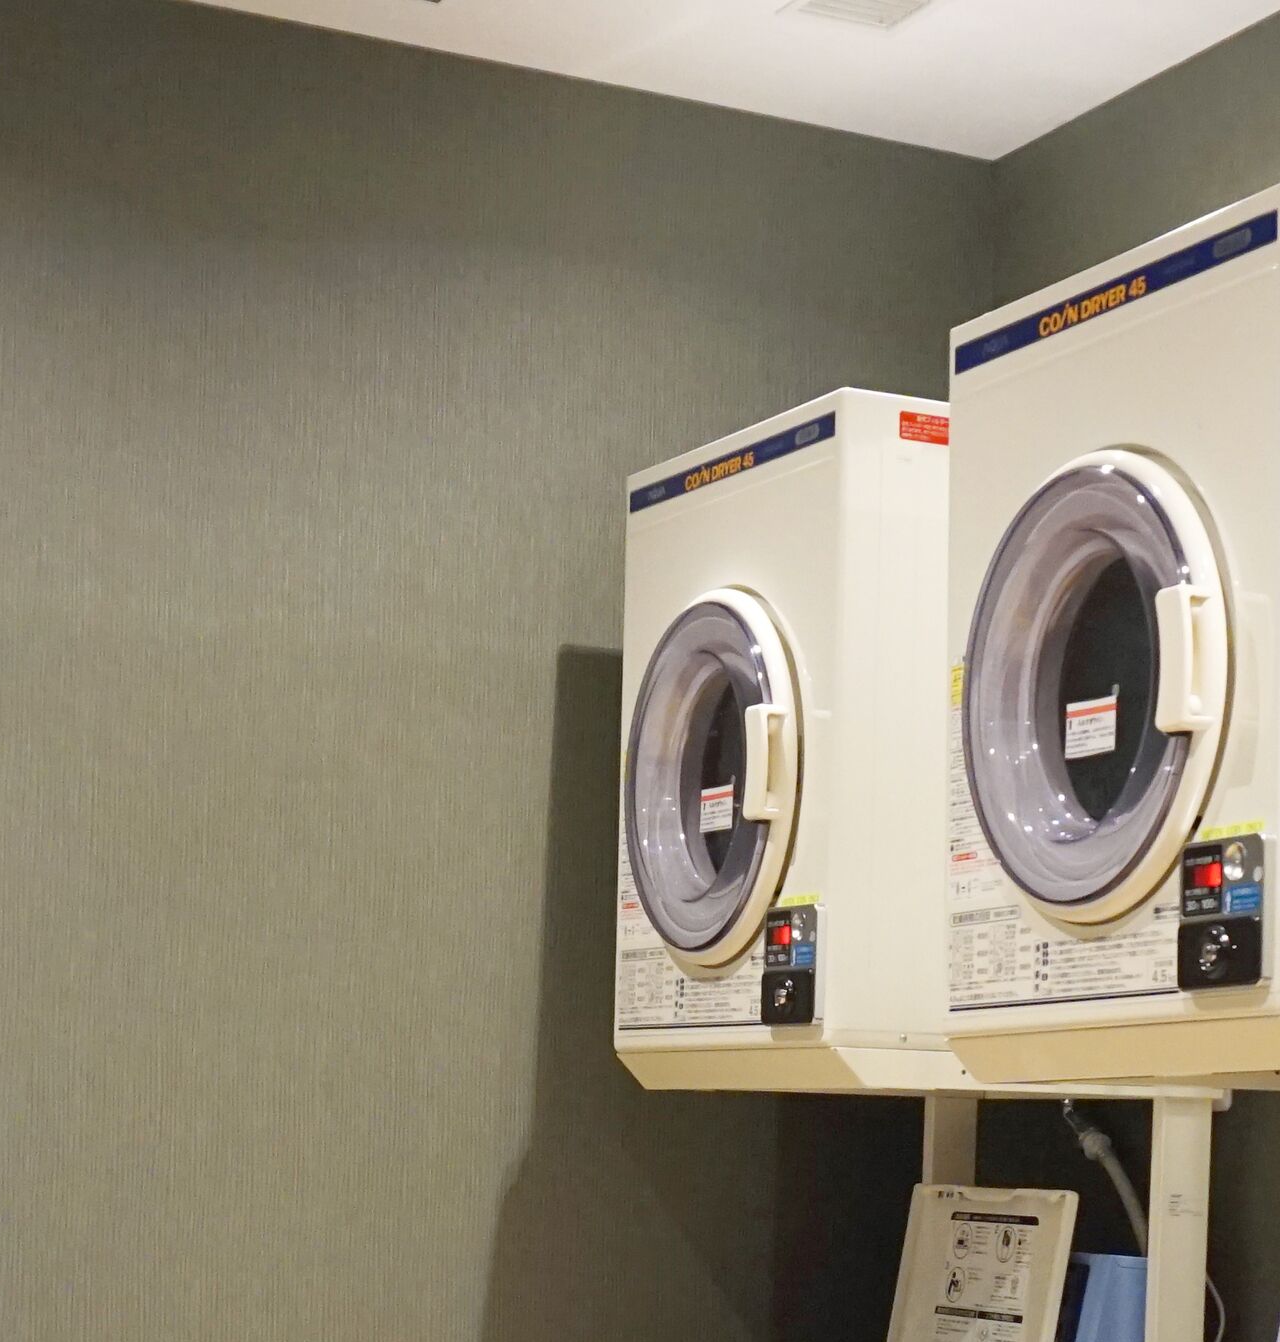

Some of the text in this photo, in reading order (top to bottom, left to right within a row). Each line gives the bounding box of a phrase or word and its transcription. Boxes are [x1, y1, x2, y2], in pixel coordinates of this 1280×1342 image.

[1081, 284, 1126, 319] DRYER
[1128, 275, 1146, 297] 45
[711, 456, 741, 480] DRYER
[742, 452, 754, 468] 45
